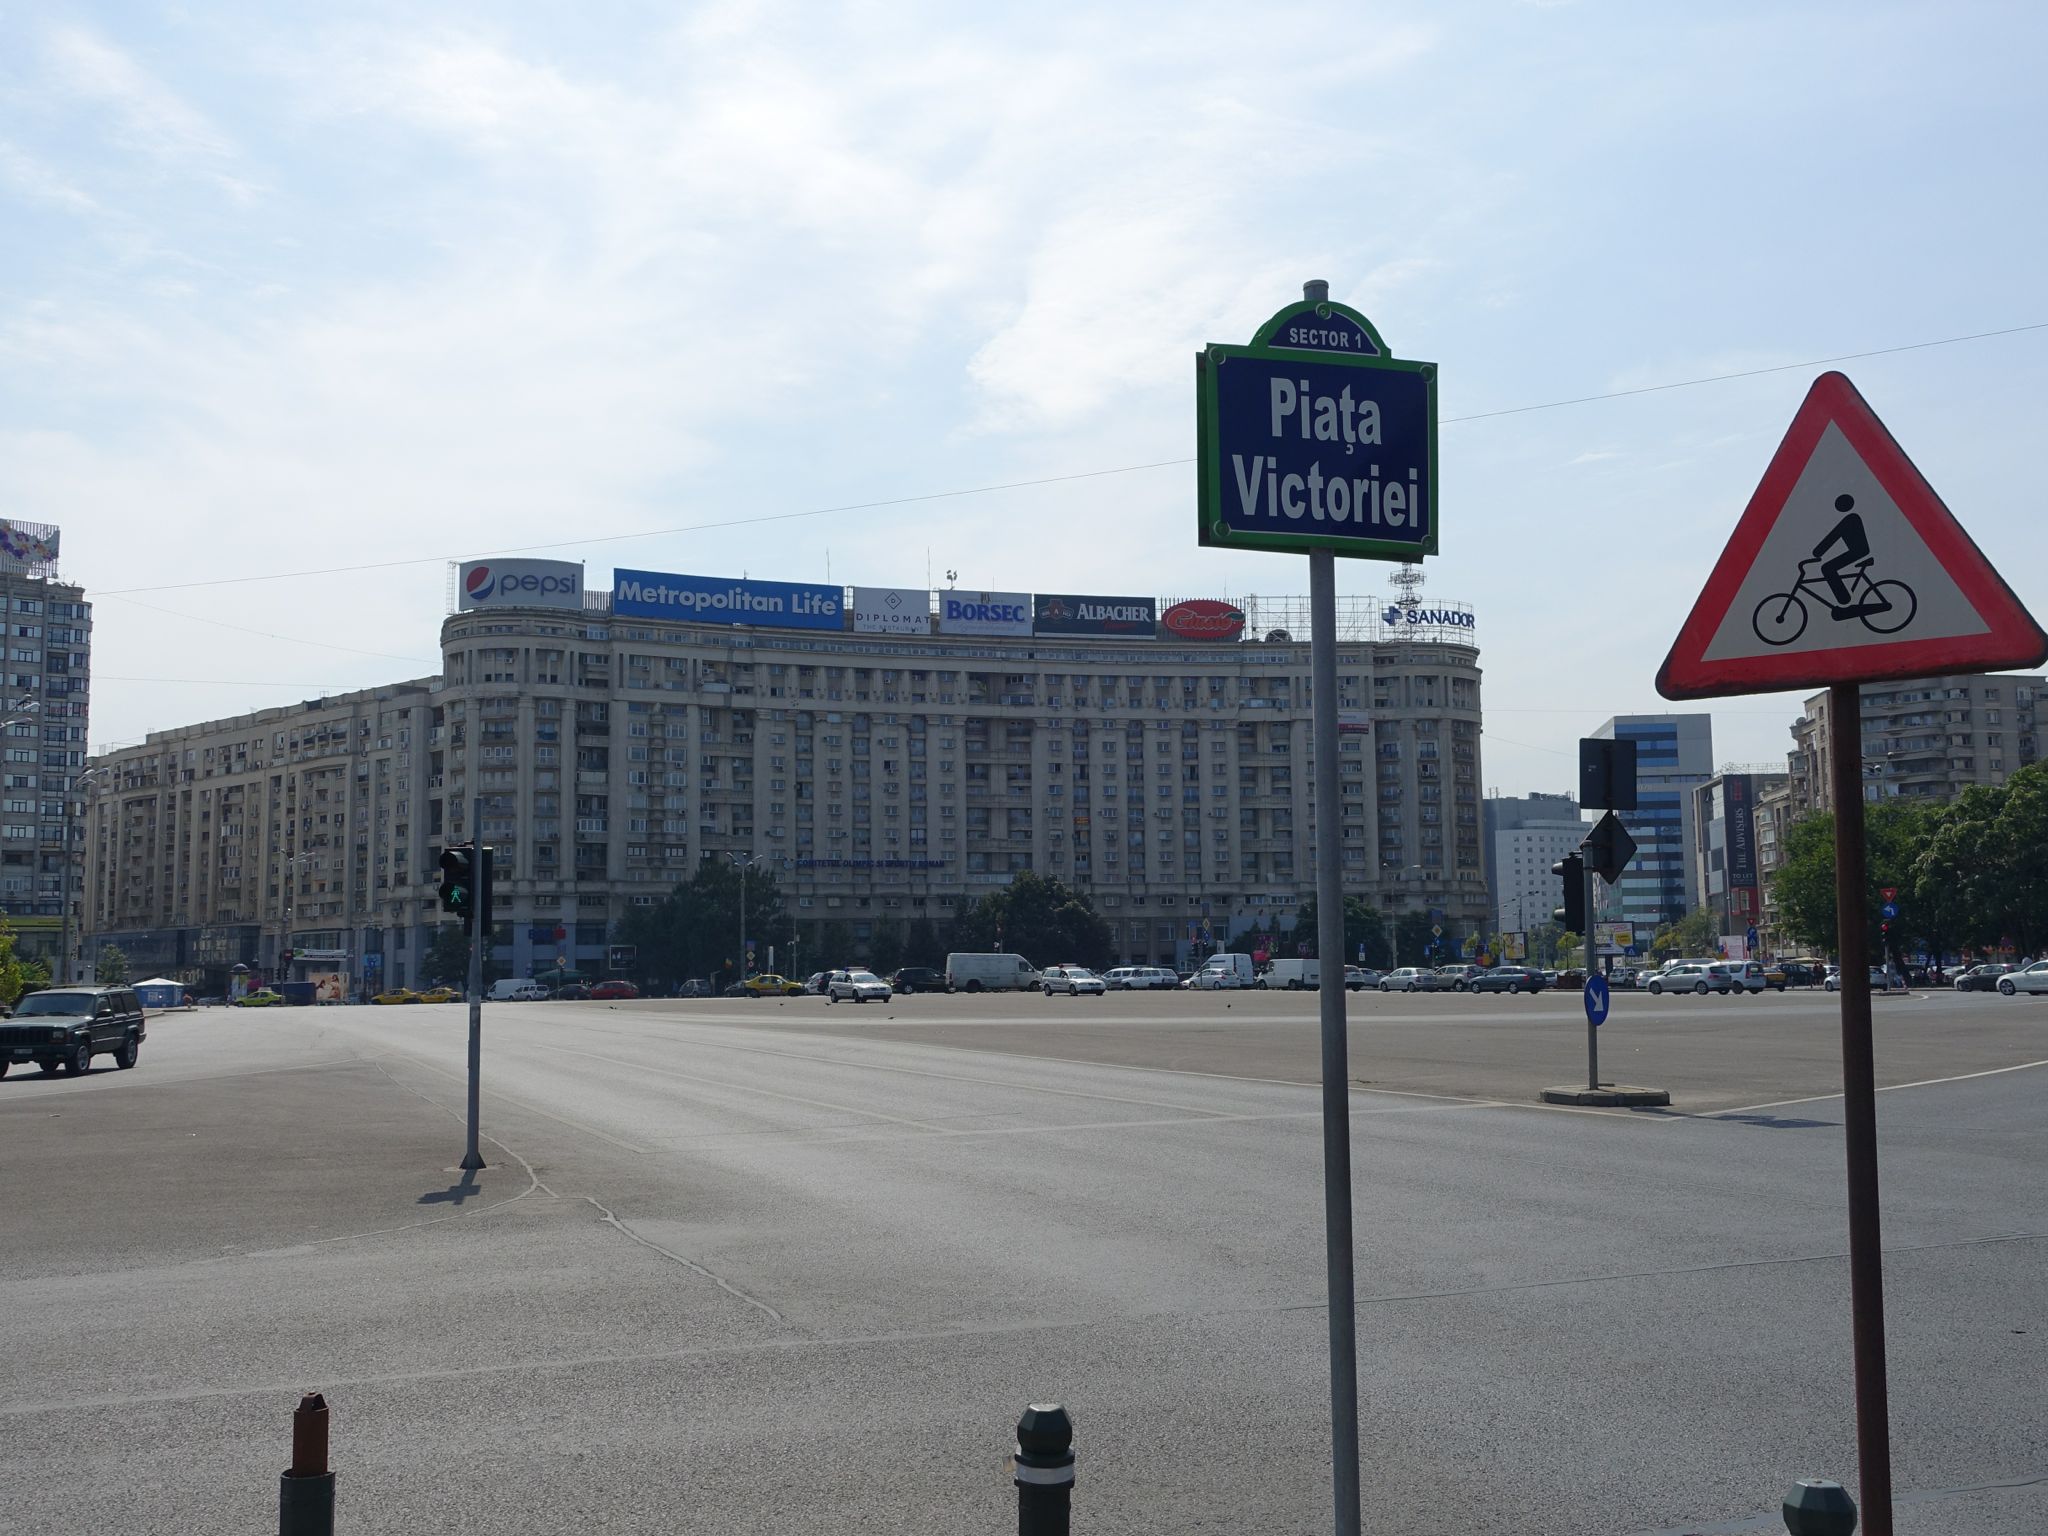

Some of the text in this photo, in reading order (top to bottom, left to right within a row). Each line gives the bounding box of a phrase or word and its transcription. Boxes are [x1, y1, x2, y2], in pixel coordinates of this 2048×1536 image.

[1289, 327, 1363, 349] SECTOR 1
[1231, 454, 1418, 528] Victoriei
[501, 573, 576, 596] pepsi
[617, 580, 784, 612] Metropolitan
[855, 613, 931, 624] DIPLOMAT
[946, 600, 1025, 622] BORSEC
[1076, 603, 1151, 622] ALBACHER
[1407, 610, 1475, 629] SANADOR
[1735, 807, 1746, 850] ADVISERS
